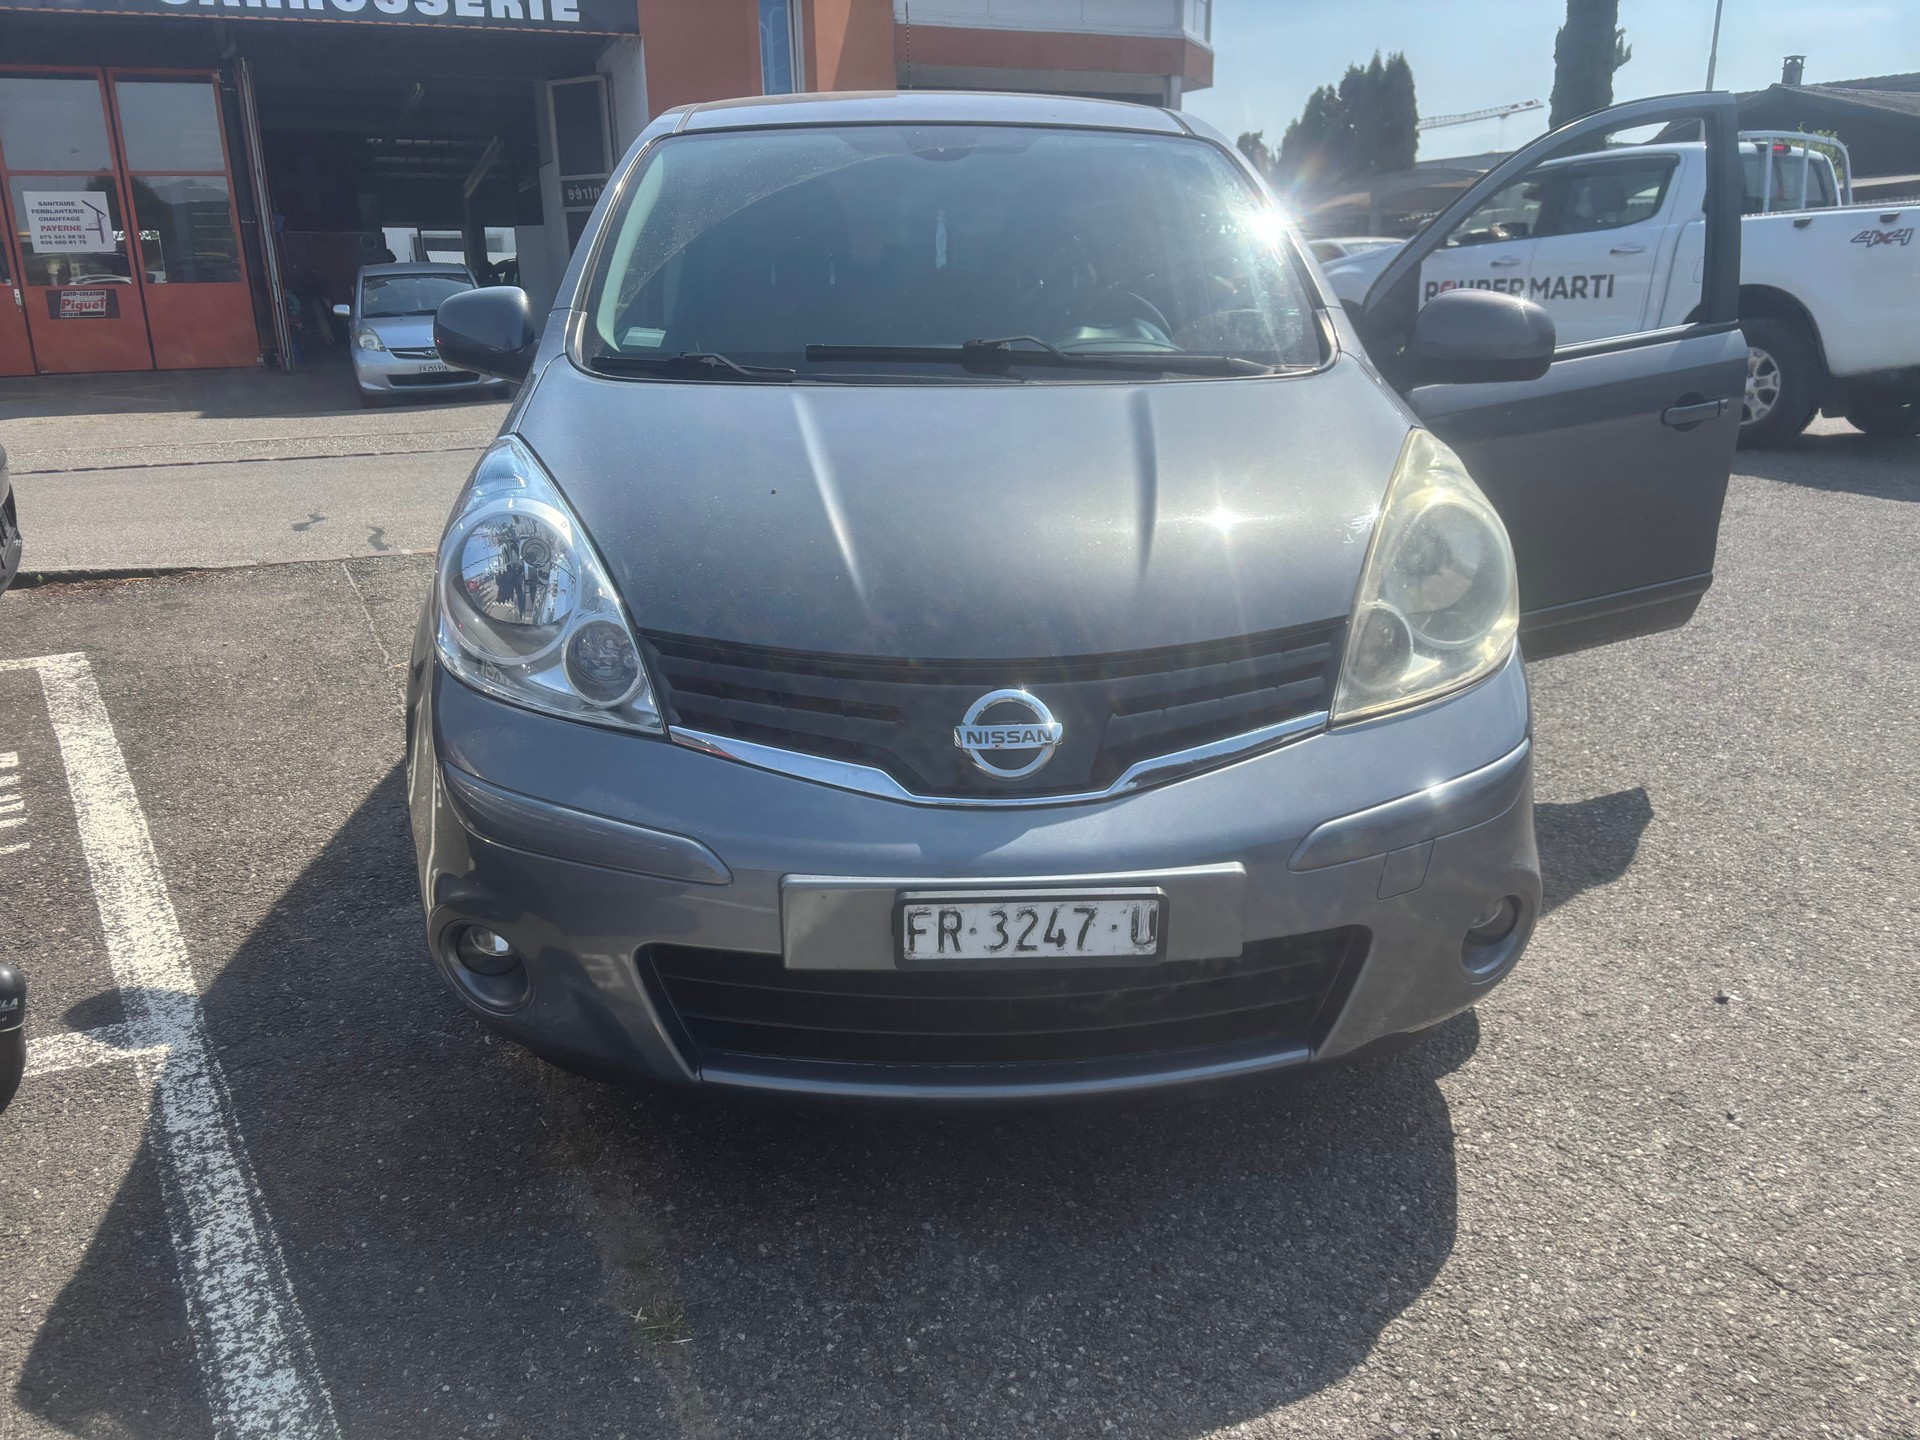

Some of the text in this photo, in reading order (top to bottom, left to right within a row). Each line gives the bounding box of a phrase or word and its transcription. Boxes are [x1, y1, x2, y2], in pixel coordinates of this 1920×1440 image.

[1530, 274, 1615, 300] MARTI
[61, 297, 106, 311] Piguet
[966, 729, 1053, 744] NISSAN
[984, 906, 1099, 951] 3247
